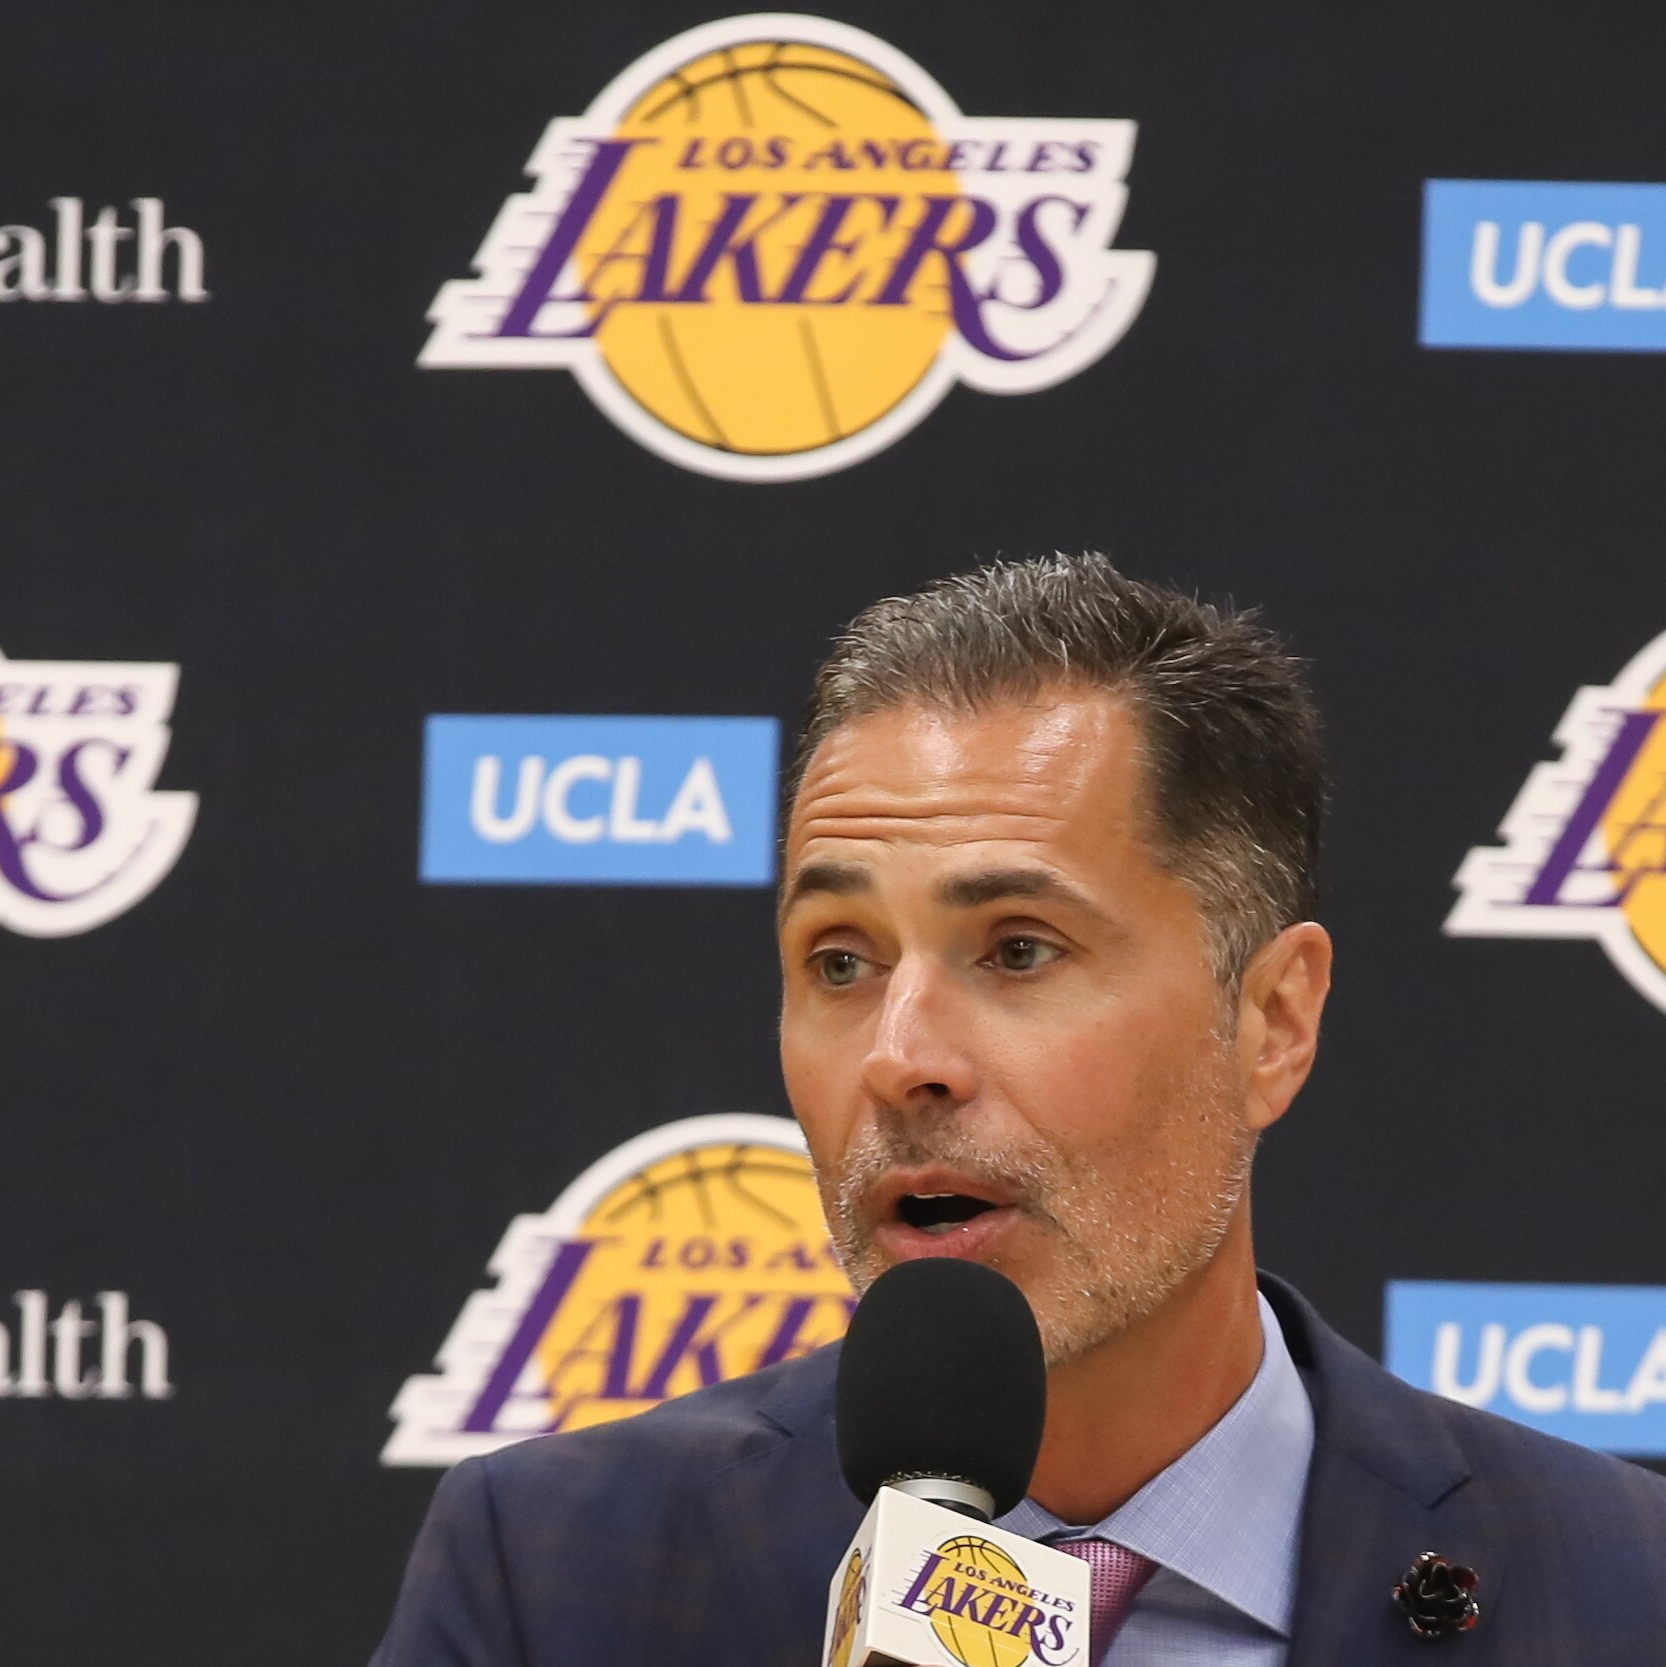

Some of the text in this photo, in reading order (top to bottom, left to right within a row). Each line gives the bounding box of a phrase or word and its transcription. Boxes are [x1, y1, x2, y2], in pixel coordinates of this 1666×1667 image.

[677, 137, 1102, 173] LOS ANGELES
[473, 137, 1119, 361] LAKERS
[469, 753, 734, 845] UCLA
[638, 1236, 752, 1271] LOS
[894, 1550, 1079, 1666] LAKERS
[953, 1562, 1076, 1612] LOS ANGELES
